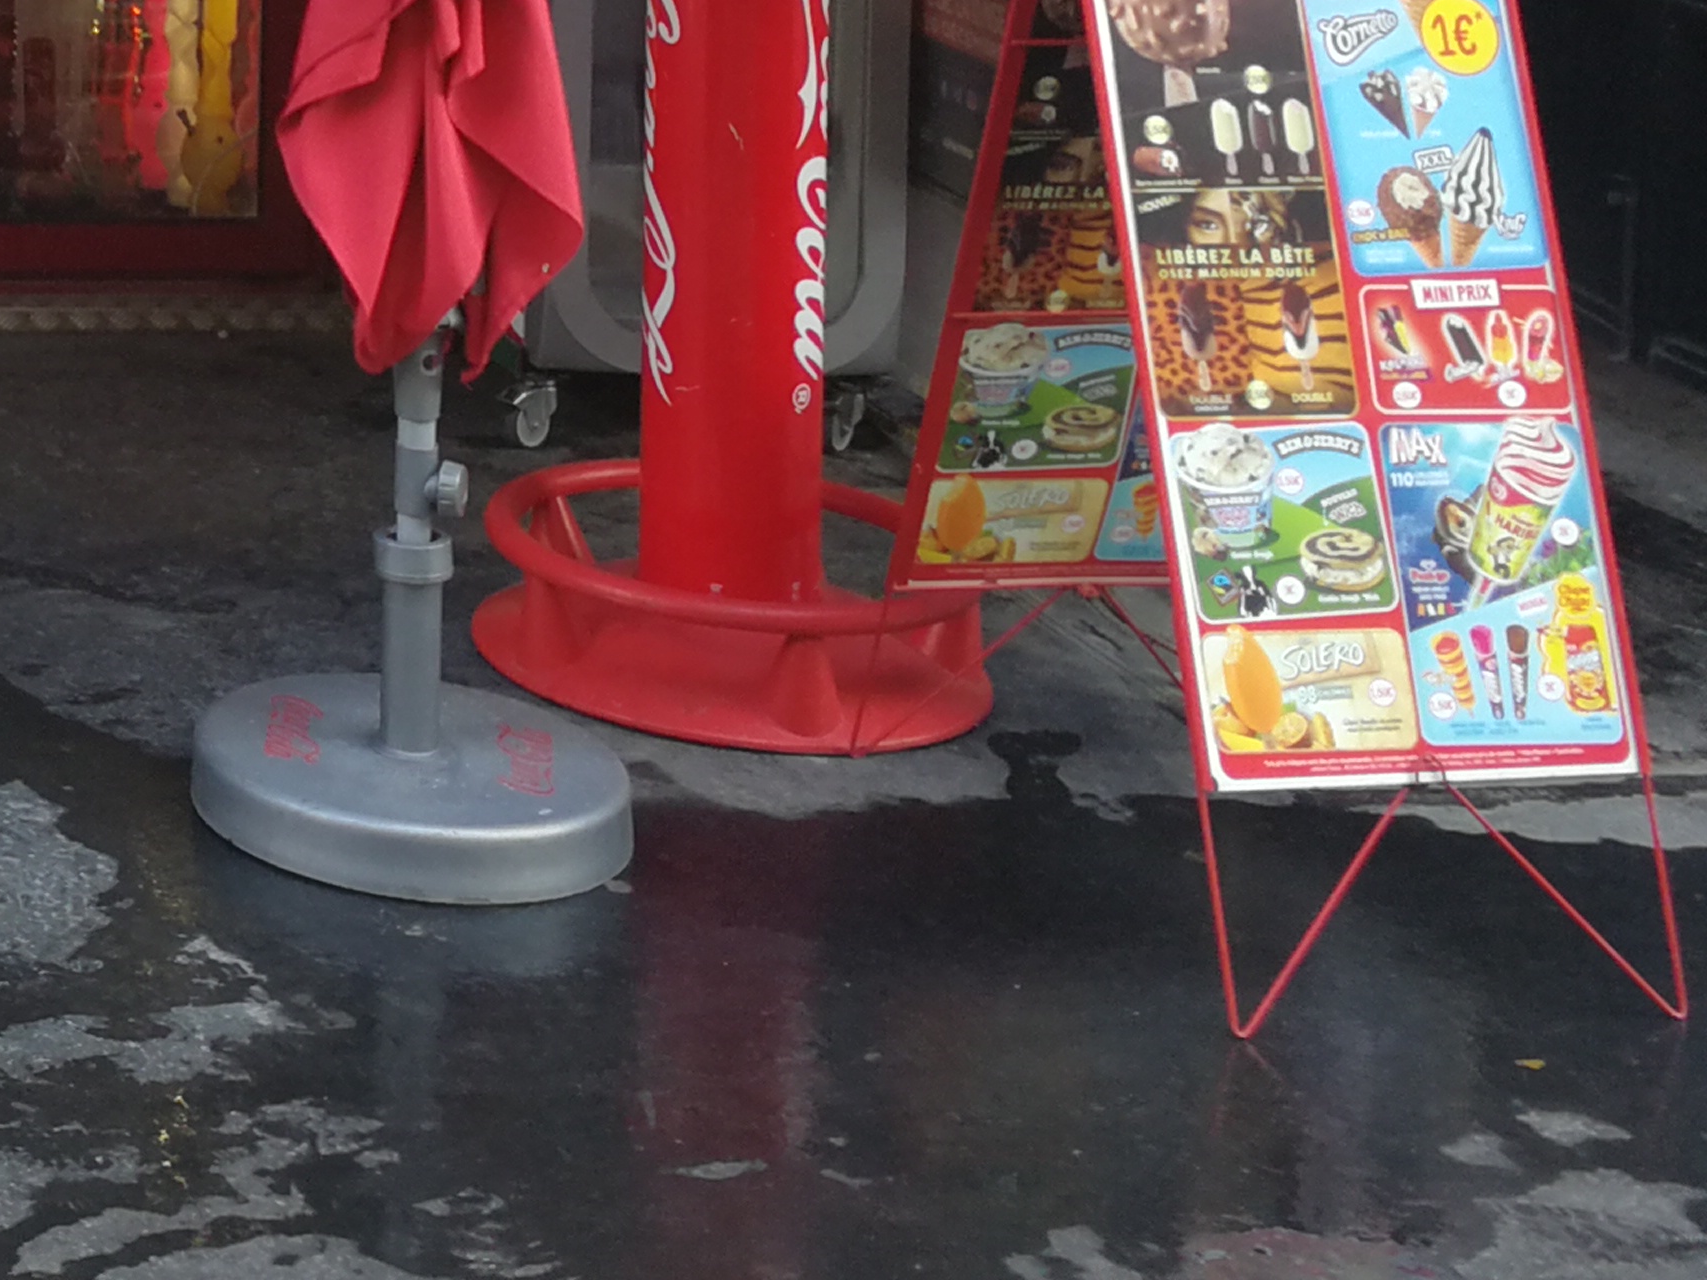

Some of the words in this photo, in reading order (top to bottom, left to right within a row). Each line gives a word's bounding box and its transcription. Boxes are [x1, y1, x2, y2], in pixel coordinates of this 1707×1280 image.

[1318, 10, 1398, 66] Cornetto
[1420, 151, 1451, 168] XXL
[1155, 246, 1233, 265] LIBÉREZ
[1239, 248, 1264, 264] LA
[1270, 244, 1316, 264] BÊTE
[1158, 268, 1193, 279] OSEZ
[1197, 267, 1261, 279] MAGNUM
[1265, 267, 1317, 278] DOUBLE
[1422, 285, 1455, 303] MINI
[1390, 426, 1447, 464] MAX
[1390, 472, 1414, 487] 110
[1280, 642, 1365, 681] SOLERO
